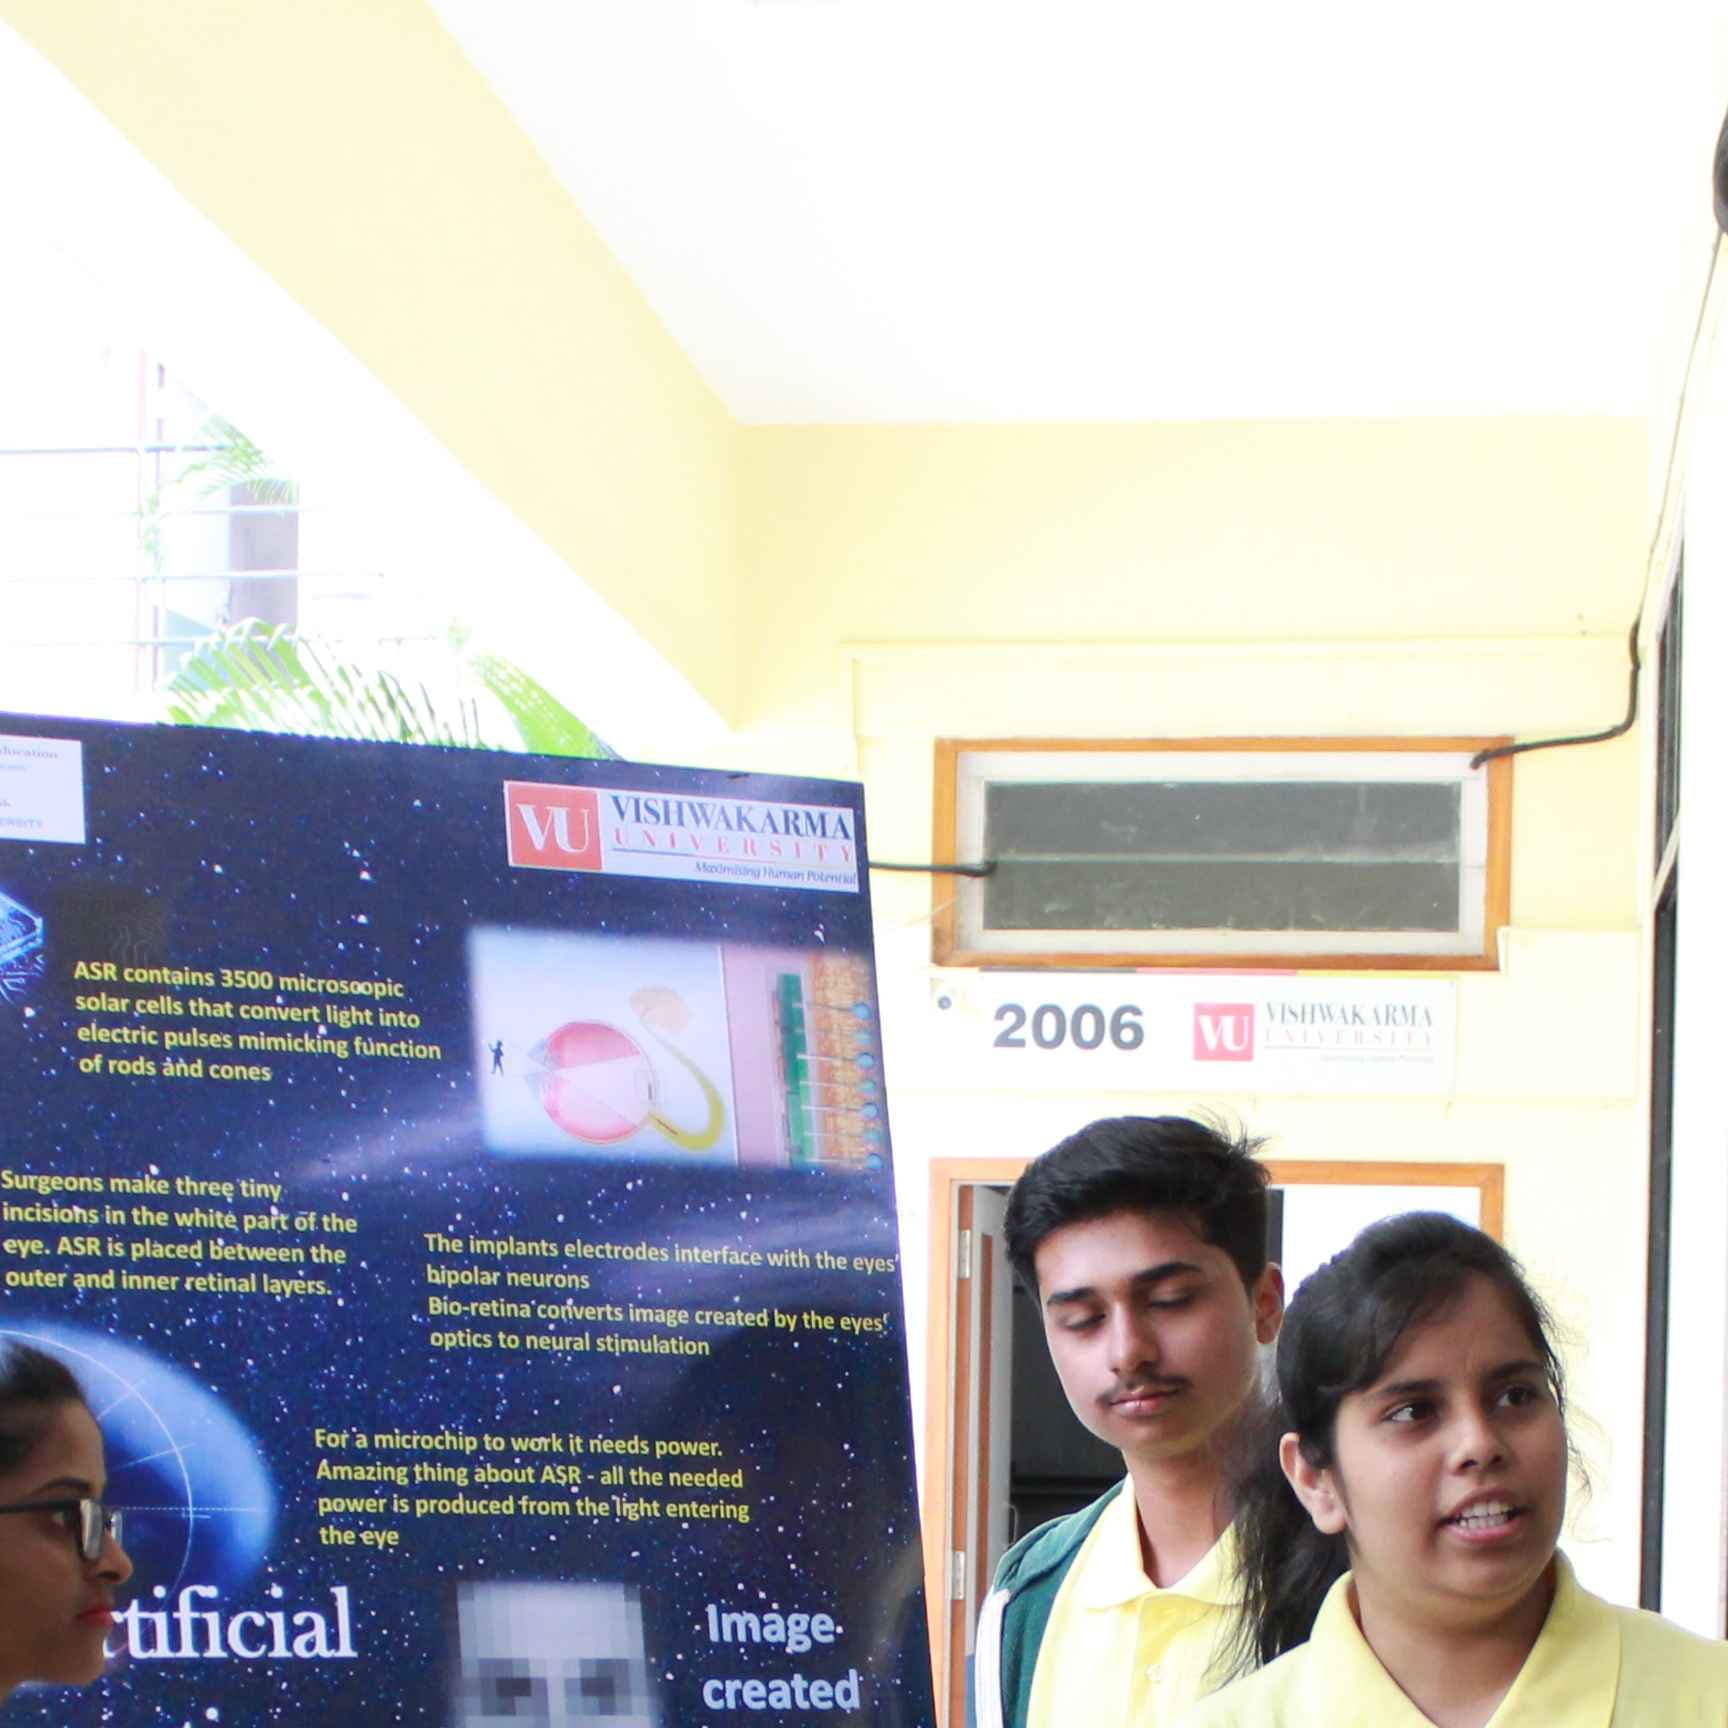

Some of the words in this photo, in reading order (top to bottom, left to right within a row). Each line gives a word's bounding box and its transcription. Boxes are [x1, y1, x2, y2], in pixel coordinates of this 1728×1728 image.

[516, 804, 591, 853] VU
[611, 795, 853, 840] VISHWAKARMA
[612, 830, 854, 862] UNIVERSITY
[696, 861, 762, 881] Maximising
[763, 867, 805, 882] Human
[807, 871, 857, 885] Potential
[73, 961, 117, 981] ASR
[124, 966, 214, 986] contains
[221, 970, 272, 990] 3500
[279, 974, 404, 1000] microscopic
[76, 993, 128, 1013] solar
[135, 996, 183, 1015] cells
[189, 999, 232, 1018] that
[239, 1005, 320, 1023] convert
[326, 1006, 373, 1029] light
[379, 1011, 419, 1029] into
[993, 1002, 1145, 1051] 2006
[1266, 1002, 1432, 1027] VISHWAKARMA
[78, 1023, 158, 1045] electric
[164, 1027, 232, 1050] pulses
[238, 1032, 348, 1059] mimicking
[354, 1038, 441, 1060] function
[1198, 1015, 1249, 1051] VU
[1264, 1028, 1432, 1045] UNIVERSITY
[108, 1056, 156, 1076] rods
[163, 1058, 203, 1078] and
[209, 1063, 271, 1081] cones
[1, 1170, 103, 1195] Surgeons
[110, 1173, 169, 1195] make
[175, 1177, 234, 1196] three
[239, 1179, 281, 1202] tiny
[3, 1202, 98, 1224] incisions
[131, 1206, 168, 1226] the
[174, 1210, 236, 1229] white
[244, 1212, 288, 1233] part
[3, 1240, 50, 1257] eye.
[57, 1237, 100, 1256] ASR
[131, 1238, 202, 1262] placed
[209, 1240, 304, 1262] between
[424, 1234, 462, 1253] The
[469, 1236, 558, 1263] implants
[564, 1239, 669, 1262] electrodes
[674, 1244, 761, 1265] interface
[766, 1246, 810, 1269] with
[816, 1249, 847, 1270] the
[5, 1269, 66, 1287] outer
[74, 1270, 114, 1289] and
[121, 1271, 179, 1290] inner
[185, 1273, 256, 1293] retinal
[263, 1274, 332, 1299] layers.
[427, 1265, 499, 1291] bipolar
[507, 1271, 590, 1290] neurons
[429, 1297, 530, 1318] Bio-retina
[538, 1303, 624, 1321] converts
[629, 1304, 689, 1327] image
[695, 1309, 768, 1326] created
[802, 1312, 834, 1329] the
[430, 1330, 491, 1351] optics
[526, 1331, 590, 1352] neural
[597, 1333, 710, 1355] stimulation
[315, 1429, 349, 1448] For
[374, 1431, 477, 1457] microchip
[511, 1433, 563, 1452] work
[590, 1436, 649, 1455] needs
[655, 1439, 722, 1460] power.
[317, 1460, 407, 1486] Amazing
[414, 1464, 468, 1486] thing
[474, 1464, 535, 1483] about
[541, 1466, 581, 1485] ASR
[601, 1467, 623, 1485] all
[670, 1469, 743, 1488] needed
[318, 1498, 387, 1515] power
[415, 1494, 515, 1518] produced
[521, 1496, 569, 1516] from
[576, 1497, 609, 1516] the
[616, 1498, 660, 1521] light
[666, 1502, 749, 1522] entering
[362, 1530, 399, 1550] eye
[103, 1585, 357, 1658] tificial
[705, 1604, 835, 1653] Image
[702, 1669, 861, 1710] created
